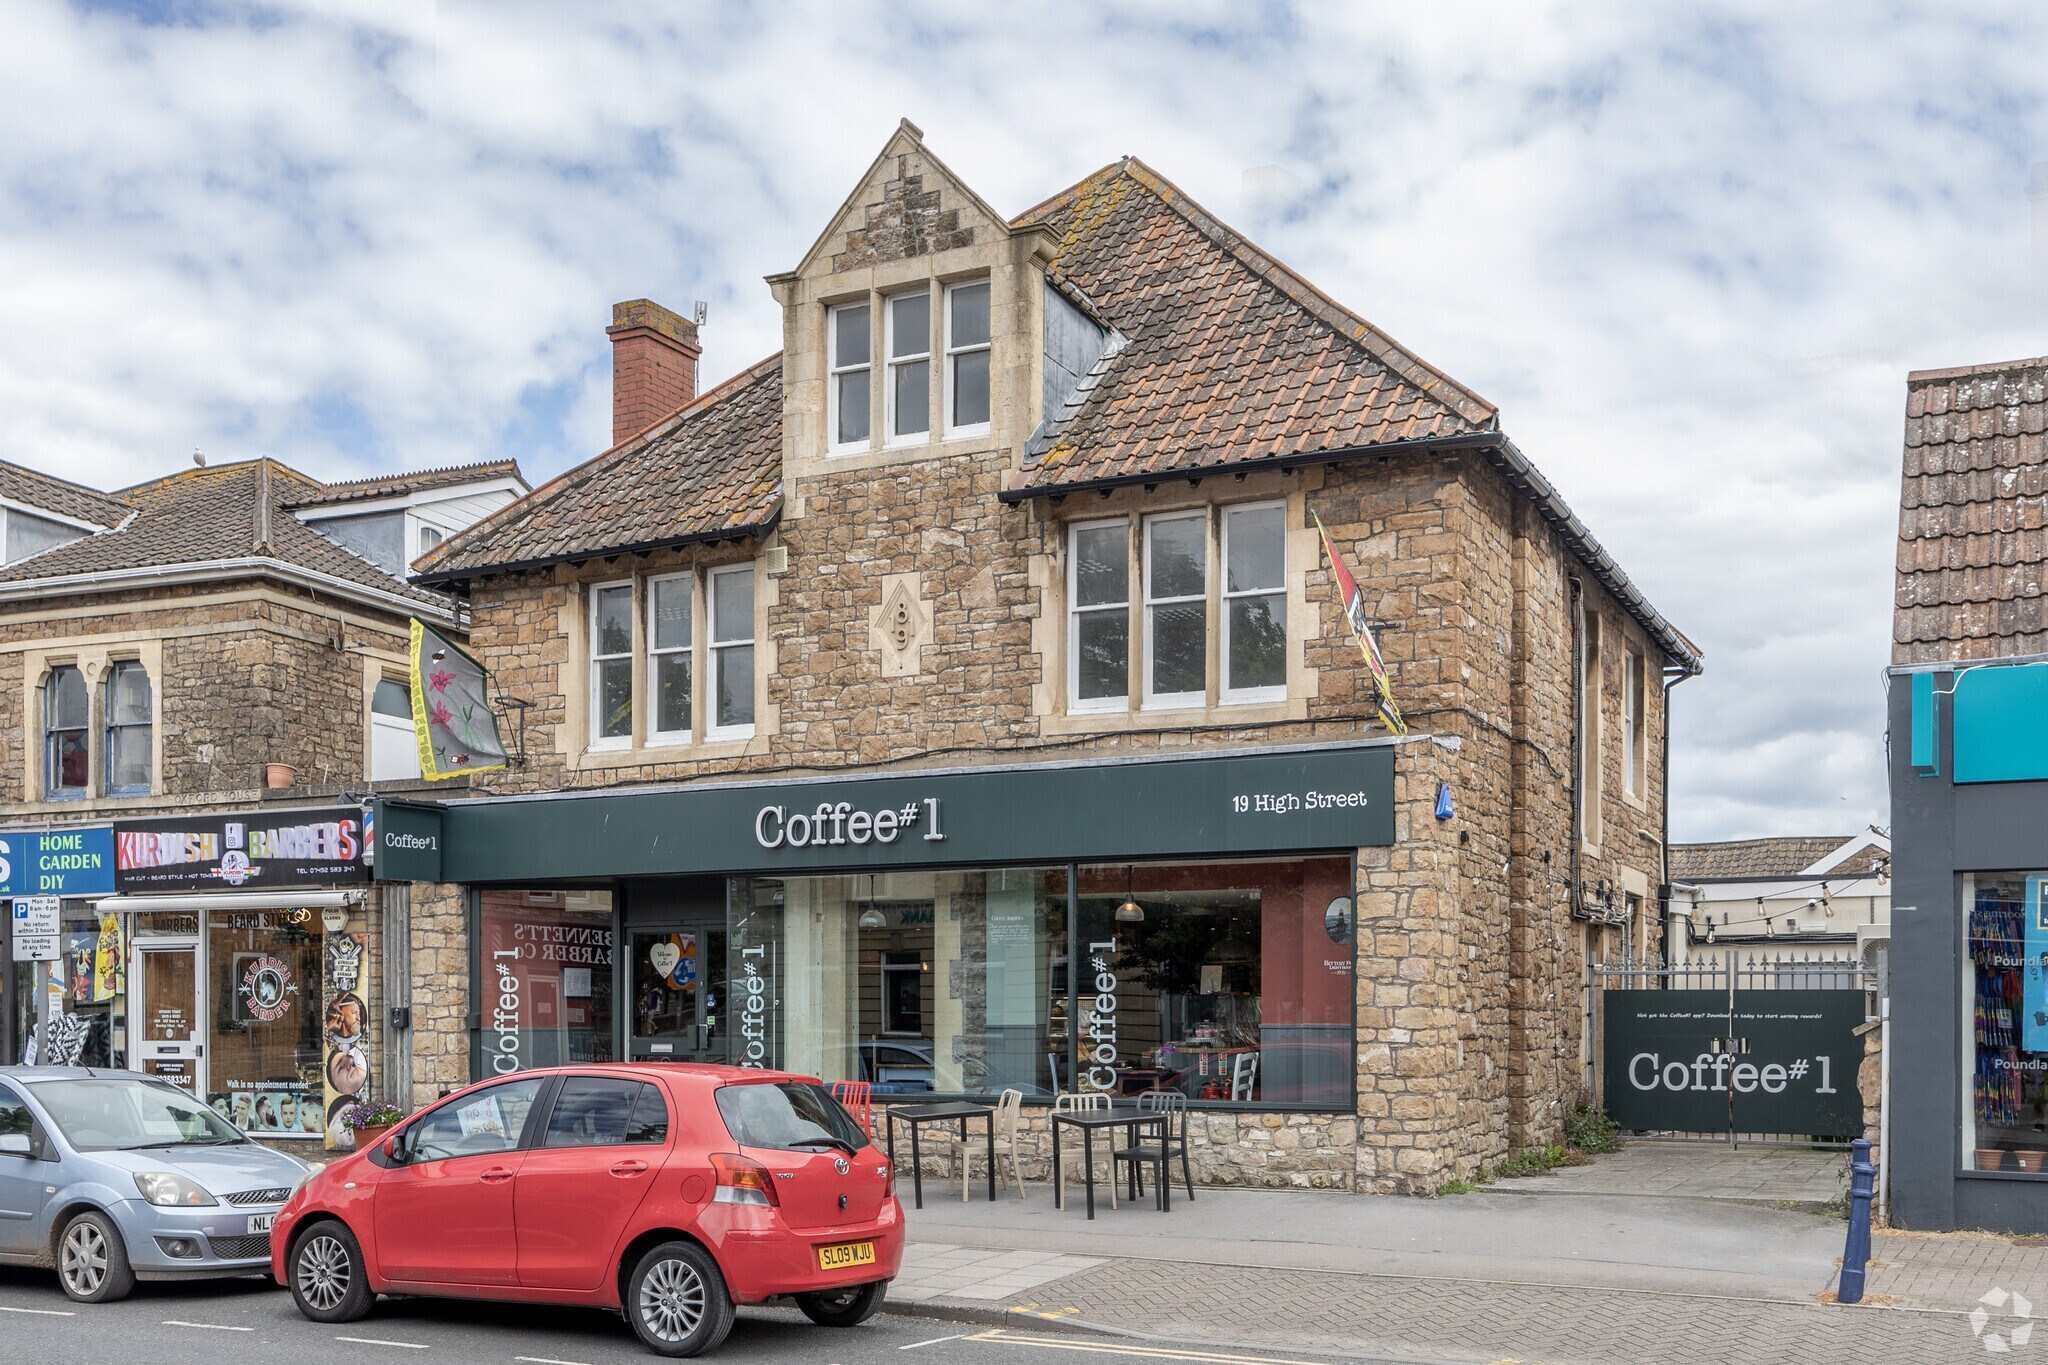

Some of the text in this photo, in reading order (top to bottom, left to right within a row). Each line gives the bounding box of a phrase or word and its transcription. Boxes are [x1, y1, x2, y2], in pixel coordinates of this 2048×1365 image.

[174, 792, 218, 804] OXFORD
[1232, 791, 1368, 814] 19 High Street
[755, 797, 946, 848] Coffee#1
[40, 835, 82, 851] HOME
[117, 819, 358, 871] KURDISH BARBERS
[385, 832, 437, 850] Coffee#1
[40, 853, 101, 871] GARDEN
[40, 875, 65, 890] DIY
[227, 914, 260, 929] BEARD
[244, 956, 292, 985] KURDISH
[246, 997, 291, 1021] BARBER
[493, 946, 519, 1074] Coffee#1
[1089, 937, 1117, 1090] Coffee#1
[1628, 1052, 1837, 1094] Coffee#1
[226, 1079, 239, 1088] Walk
[240, 1080, 246, 1088] in
[255, 1080, 288, 1090] appointment
[289, 1081, 309, 1089] needed
[823, 1244, 871, 1265] SL09 WJU
